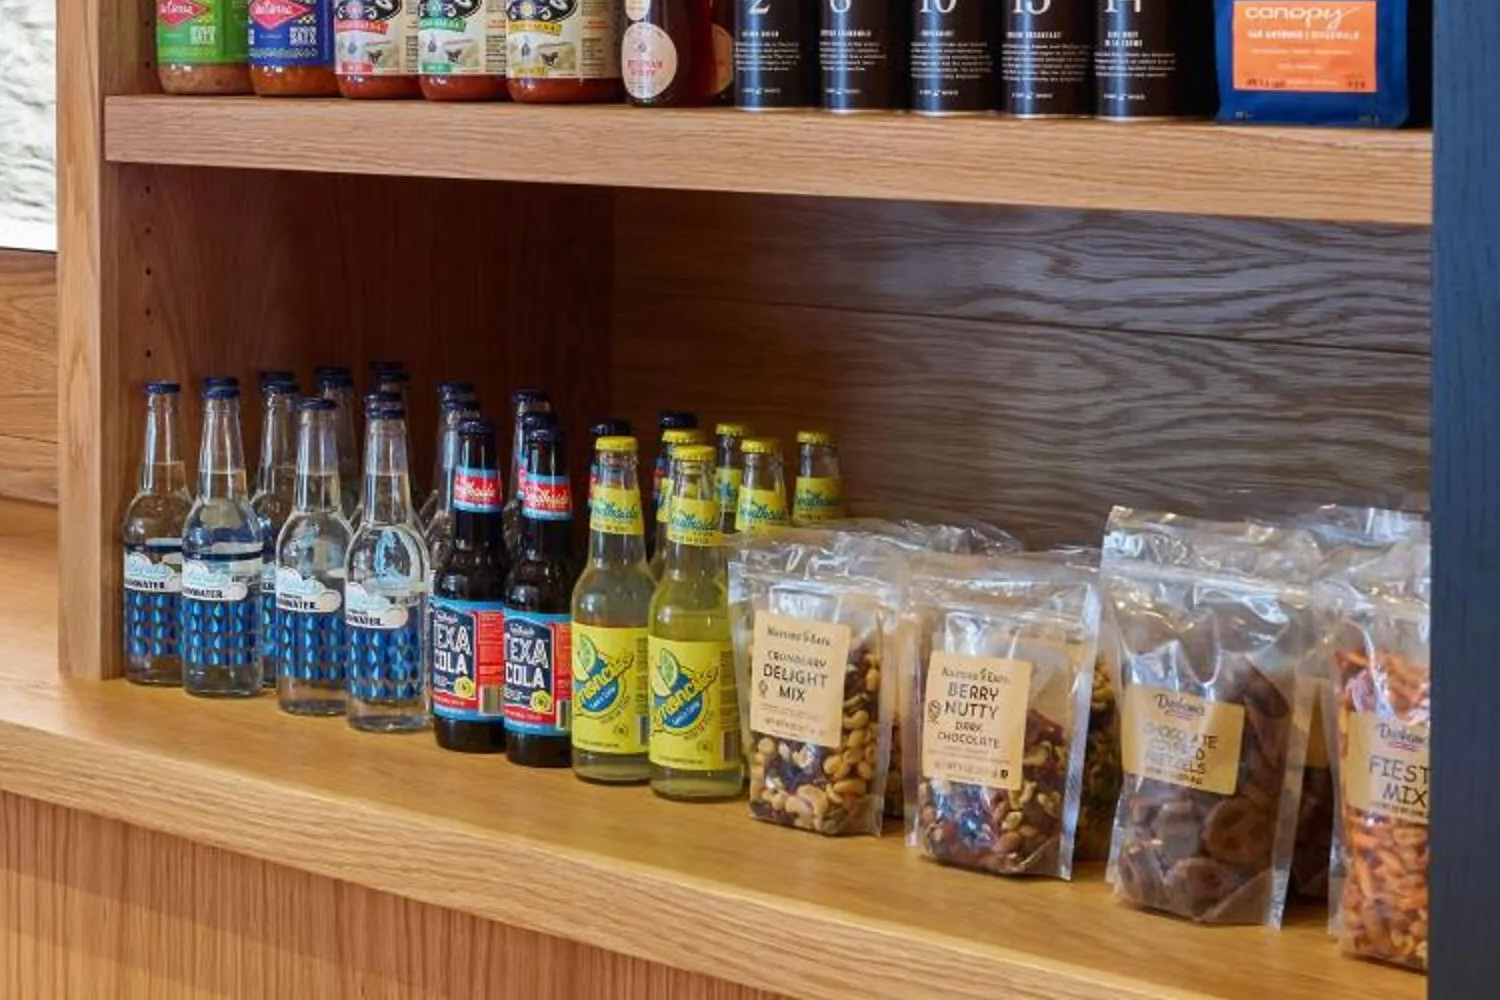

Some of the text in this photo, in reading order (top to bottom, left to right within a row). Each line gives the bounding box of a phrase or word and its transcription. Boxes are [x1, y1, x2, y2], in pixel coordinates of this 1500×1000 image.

[1244, 5, 1360, 29] canopy
[434, 648, 468, 675] COLA
[505, 661, 545, 688] COLA
[763, 663, 828, 689] DELIGHT
[779, 685, 806, 702] MIX
[948, 681, 999, 702] BERRY
[944, 699, 1000, 721] NUTTY
[955, 720, 983, 733] DARK
[938, 731, 1003, 749] CHOCOLATE
[1382, 782, 1428, 808] MIX
